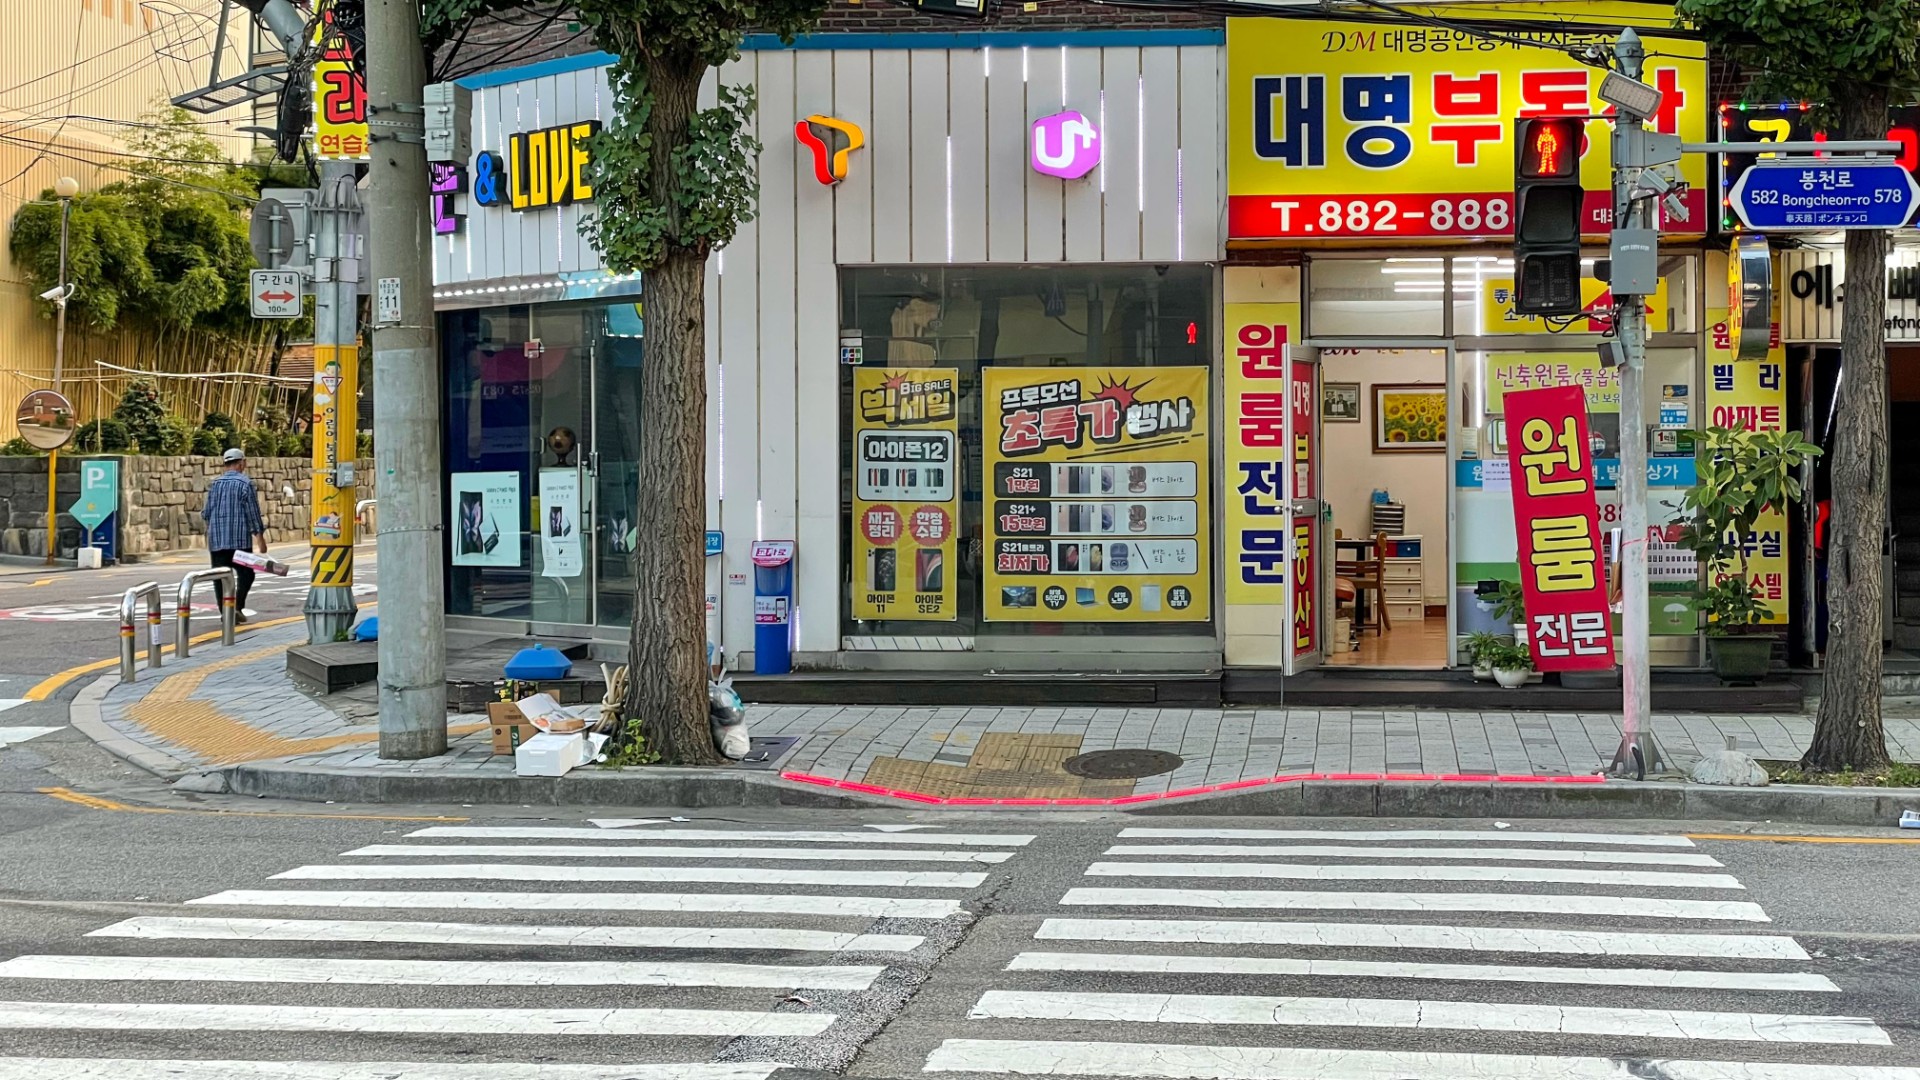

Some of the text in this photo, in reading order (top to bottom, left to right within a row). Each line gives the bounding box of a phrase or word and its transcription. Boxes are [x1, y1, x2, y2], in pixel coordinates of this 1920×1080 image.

[1321, 30, 1376, 53] DM
[320, 134, 369, 154] 연습
[510, 123, 593, 209] LOVE
[1799, 170, 1854, 190] 봉천로
[1751, 189, 1902, 208] 582 Bongcheon-ro 578
[1270, 199, 1515, 232] T.882-888
[384, 295, 397, 309] 11
[900, 379, 951, 395] BIG SALE
[1002, 380, 1079, 409] 프로모션
[861, 388, 952, 423] 빅세일
[1002, 397, 1190, 452] 초특가 행사
[1712, 405, 1781, 433] 아파트
[867, 440, 944, 460] 아이폰12
[87, 467, 104, 489] P
[1013, 467, 1033, 478] S21
[1005, 476, 1040, 494] 1만원
[1010, 504, 1036, 515] S21+
[1520, 415, 1596, 592] 원룸
[868, 512, 895, 525] 재고
[1000, 515, 1046, 532] 15만원
[868, 525, 895, 538] 정리
[876, 604, 886, 613] 11
[918, 604, 941, 614] SE2
[1533, 611, 1608, 657] 전문
